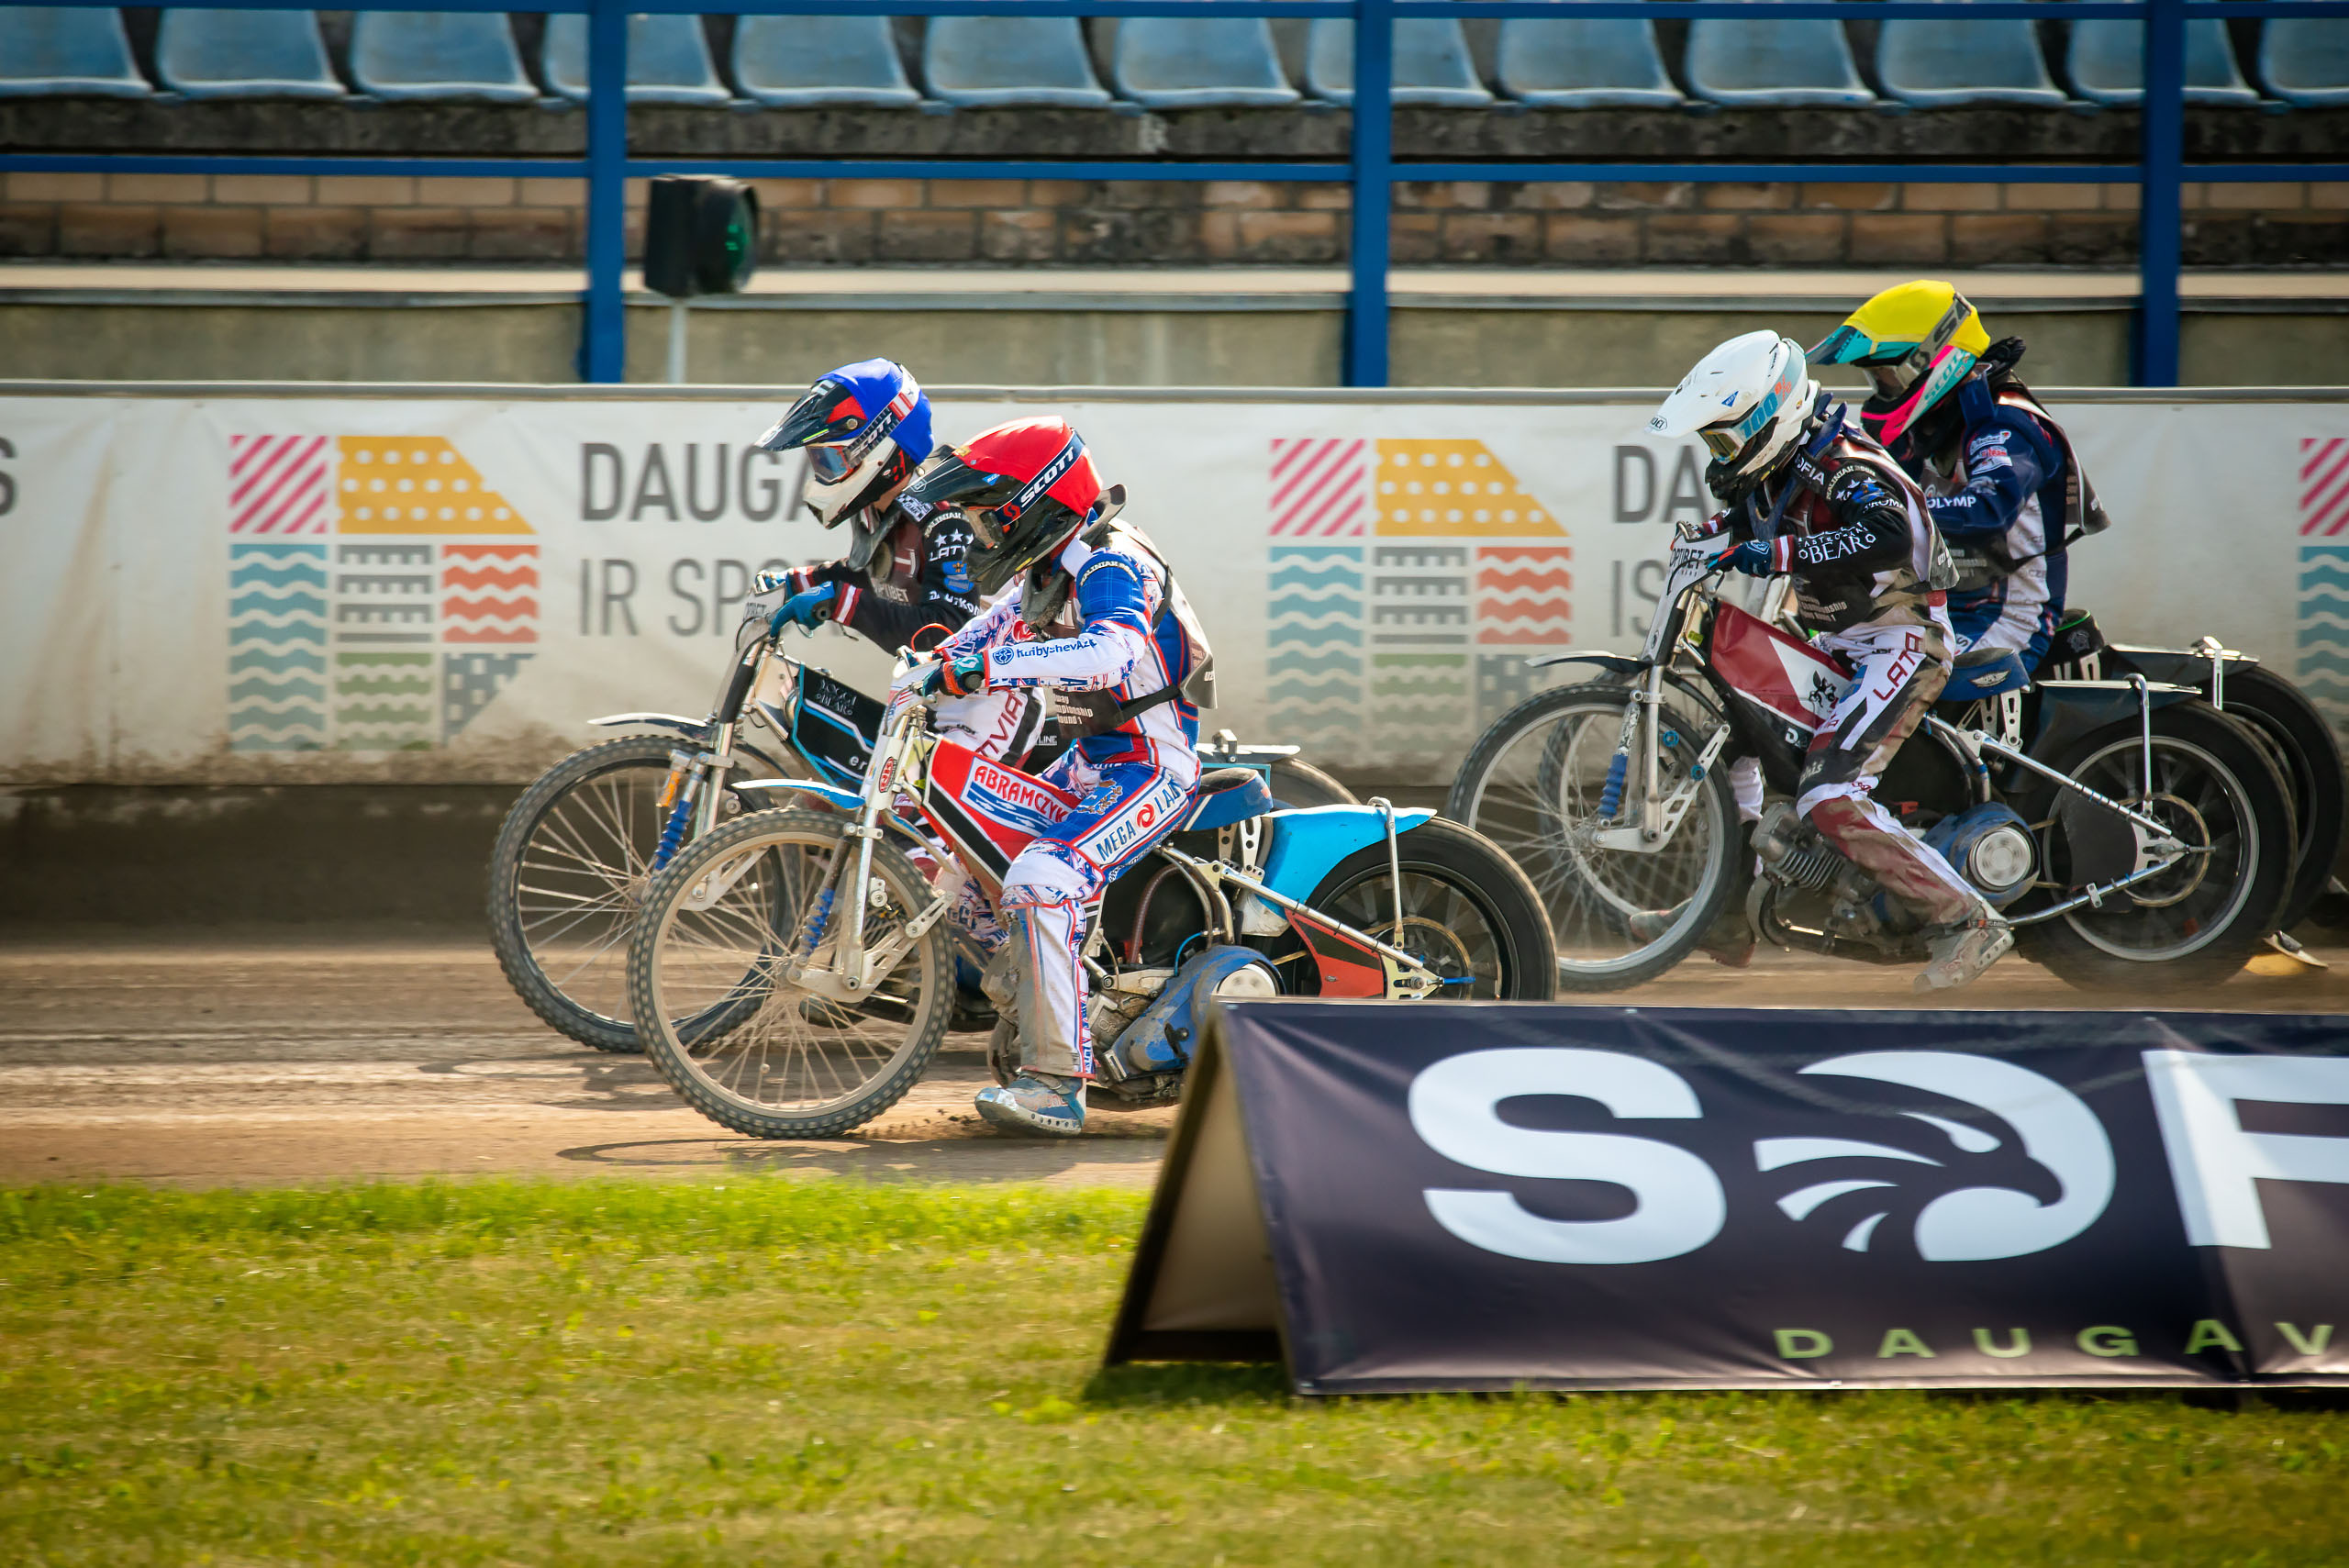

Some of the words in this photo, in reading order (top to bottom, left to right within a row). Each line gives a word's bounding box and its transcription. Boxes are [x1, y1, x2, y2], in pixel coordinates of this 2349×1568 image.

[849, 411, 893, 457] SCOTT
[1740, 374, 1792, 439] 100%
[1019, 446, 1075, 507] SCOTT
[1809, 536, 1871, 564] BEAR
[578, 559, 639, 637] IR
[974, 765, 1070, 823] ABRAMCZYK
[1096, 819, 1136, 861] MEGA
